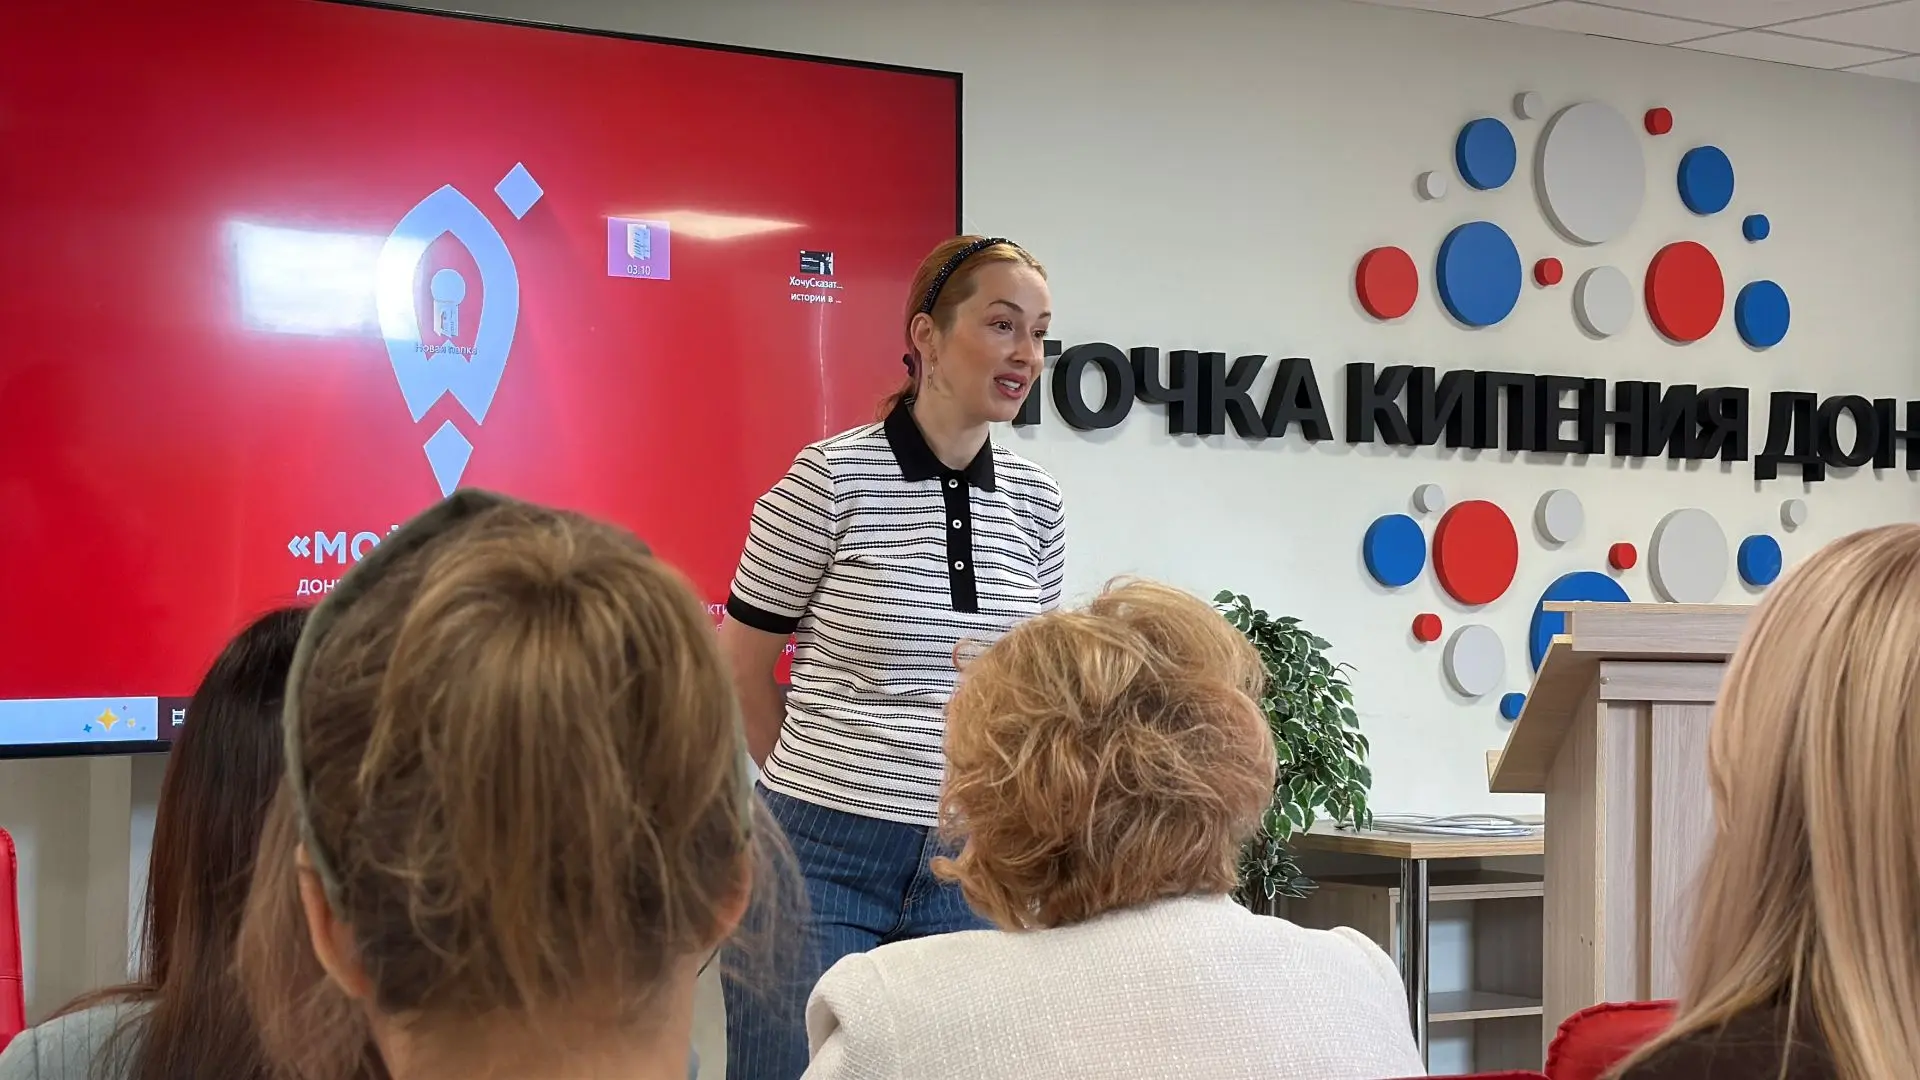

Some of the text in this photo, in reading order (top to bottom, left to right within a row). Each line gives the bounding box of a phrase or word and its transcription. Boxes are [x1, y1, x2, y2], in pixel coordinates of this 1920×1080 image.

[627, 264, 651, 276] 03.10
[791, 293, 826, 303] истории
[828, 295, 834, 303] в
[416, 342, 477, 356] Новая папка
[1346, 362, 1750, 462] КИПЕНИЯ
[287, 524, 399, 564] «МО
